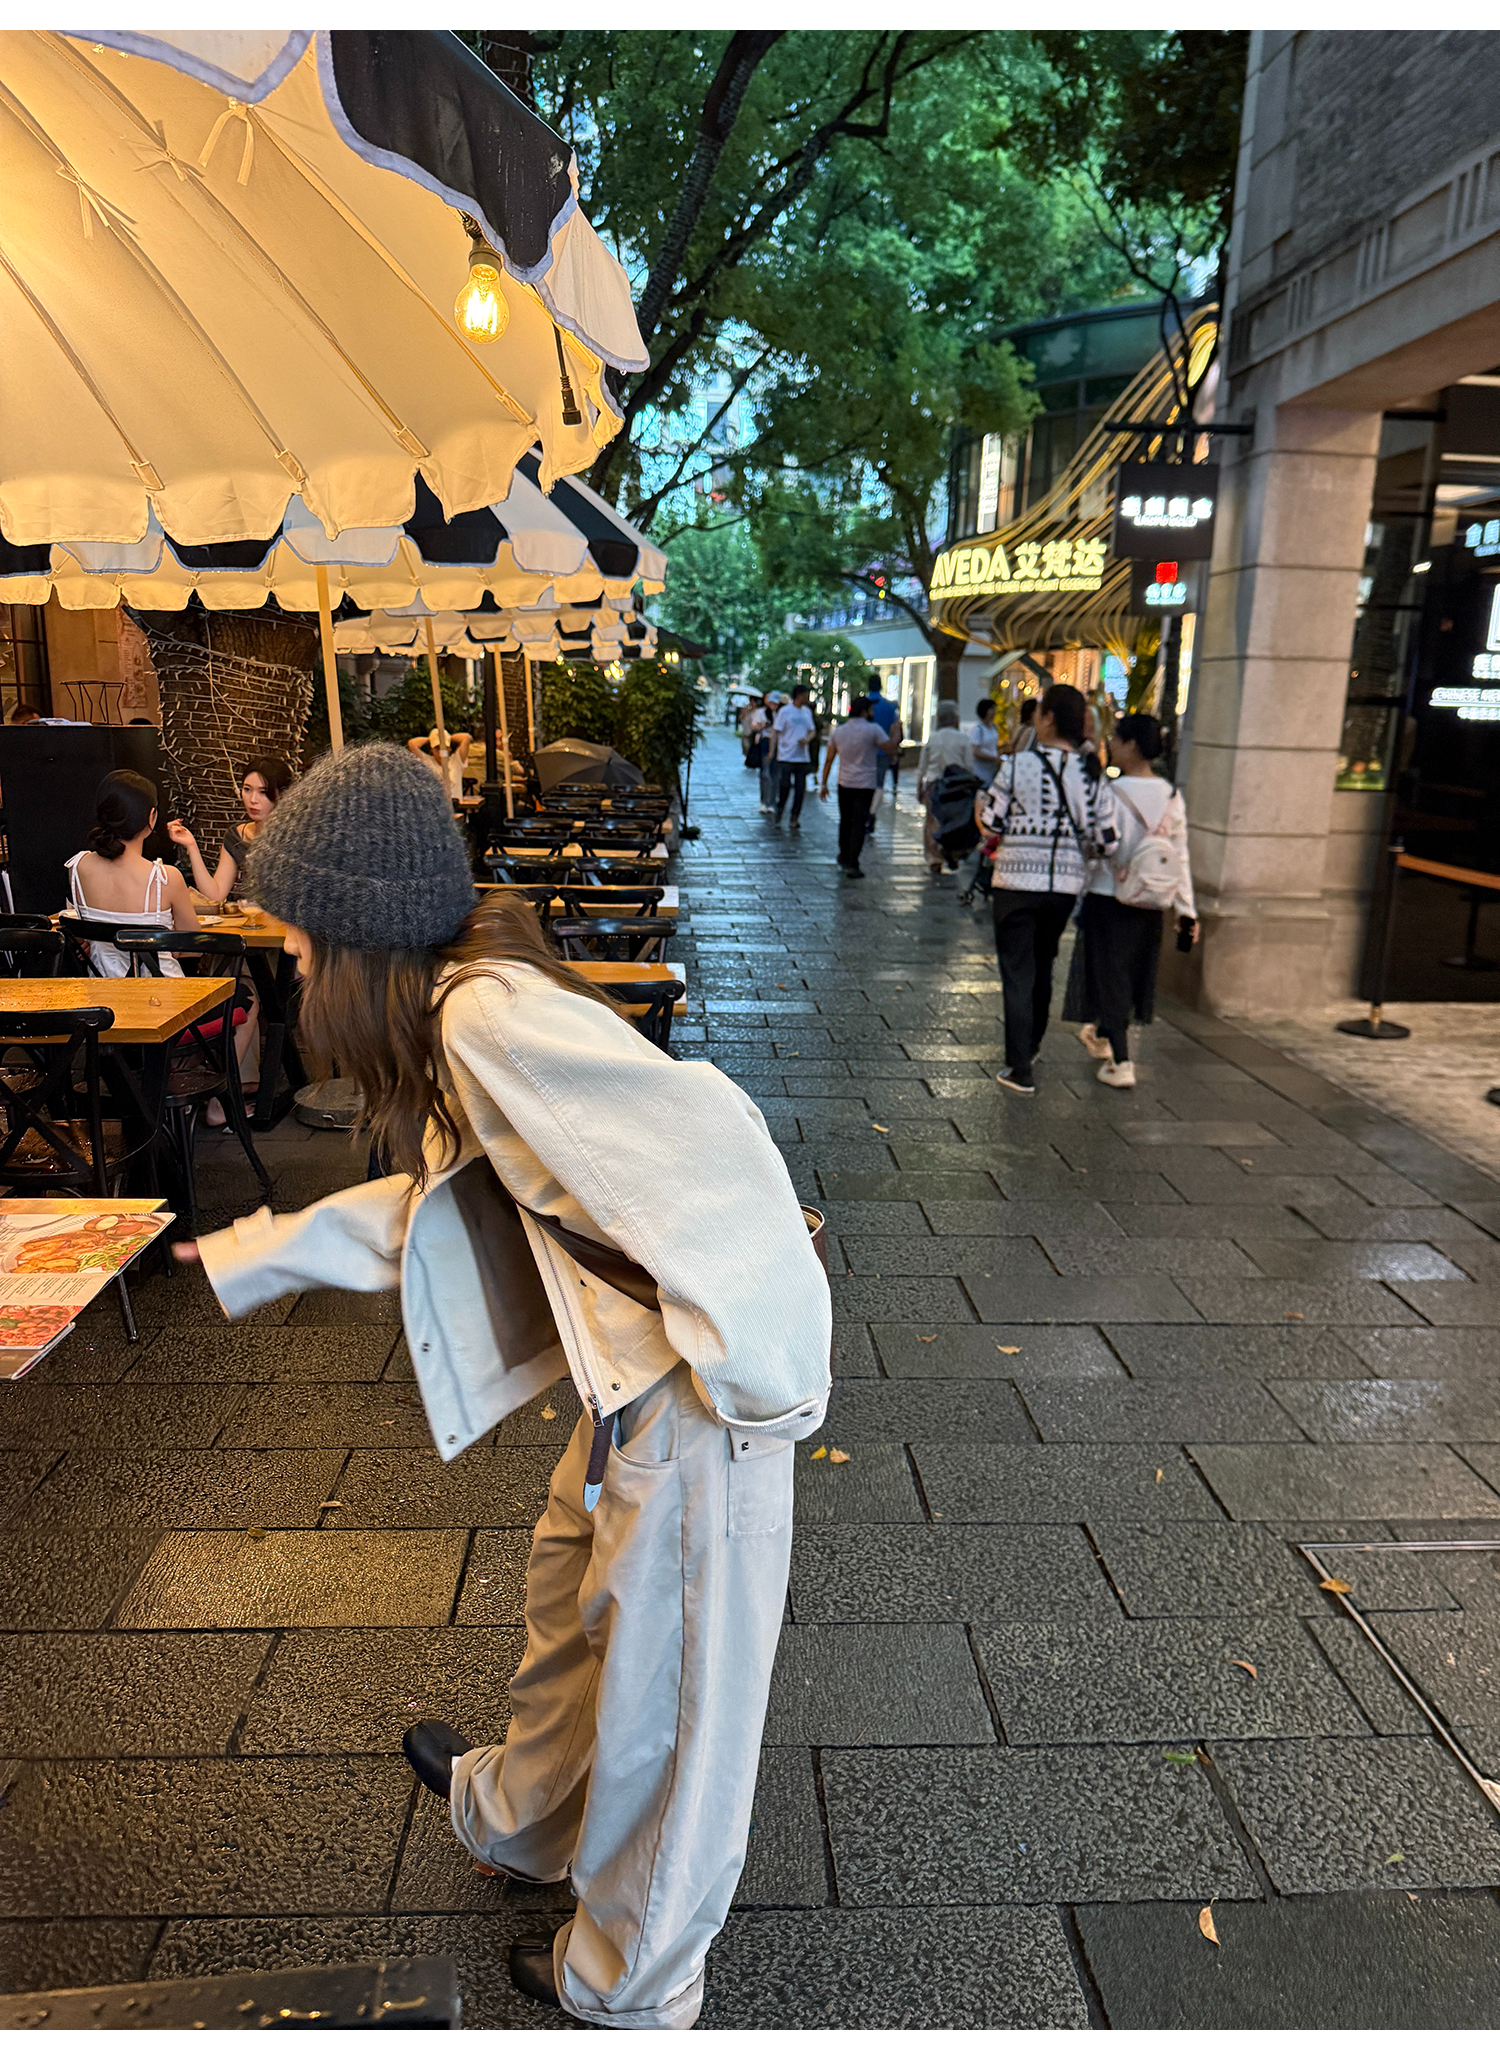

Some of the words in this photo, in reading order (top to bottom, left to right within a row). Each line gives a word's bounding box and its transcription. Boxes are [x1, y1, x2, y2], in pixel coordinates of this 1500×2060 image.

[930, 544, 1010, 588] AVEDA
[1013, 537, 1107, 579] 艾梵达
